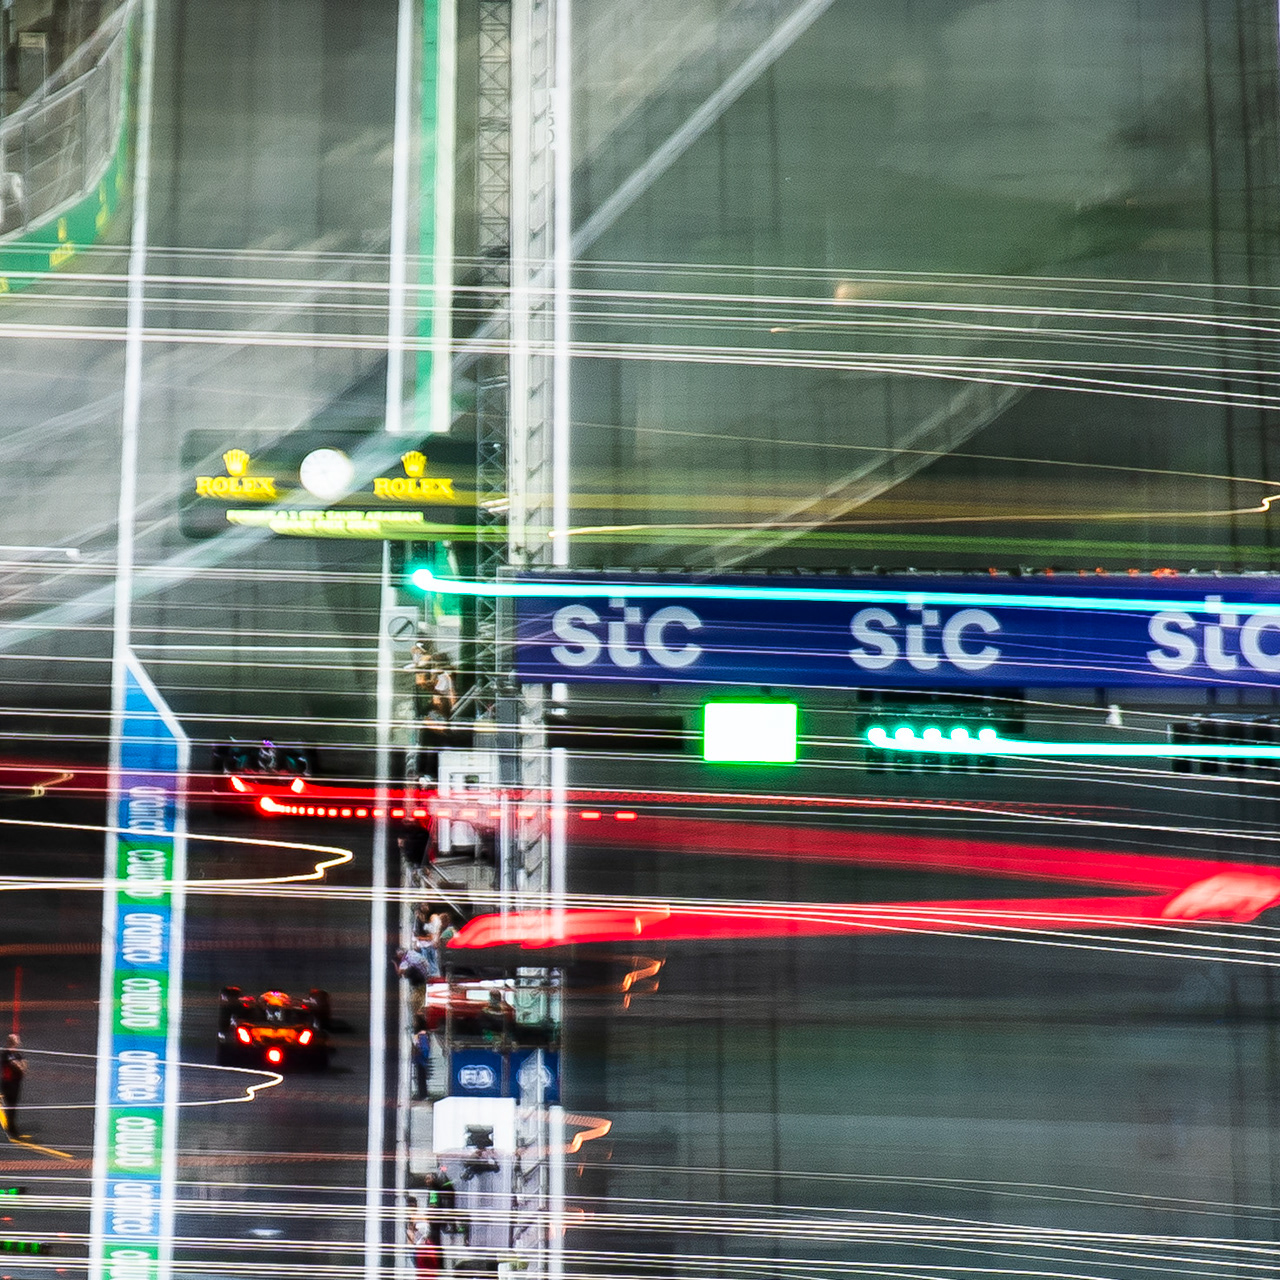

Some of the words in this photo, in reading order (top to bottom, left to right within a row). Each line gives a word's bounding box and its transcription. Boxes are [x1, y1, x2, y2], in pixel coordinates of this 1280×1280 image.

[195, 476, 277, 497] ROLEX
[373, 477, 455, 498] ROLEX
[551, 592, 703, 667] stc
[849, 593, 1001, 670] stc
[122, 913, 162, 963] aramco
[120, 977, 162, 1029] aramco
[115, 1116, 157, 1169] aramco
